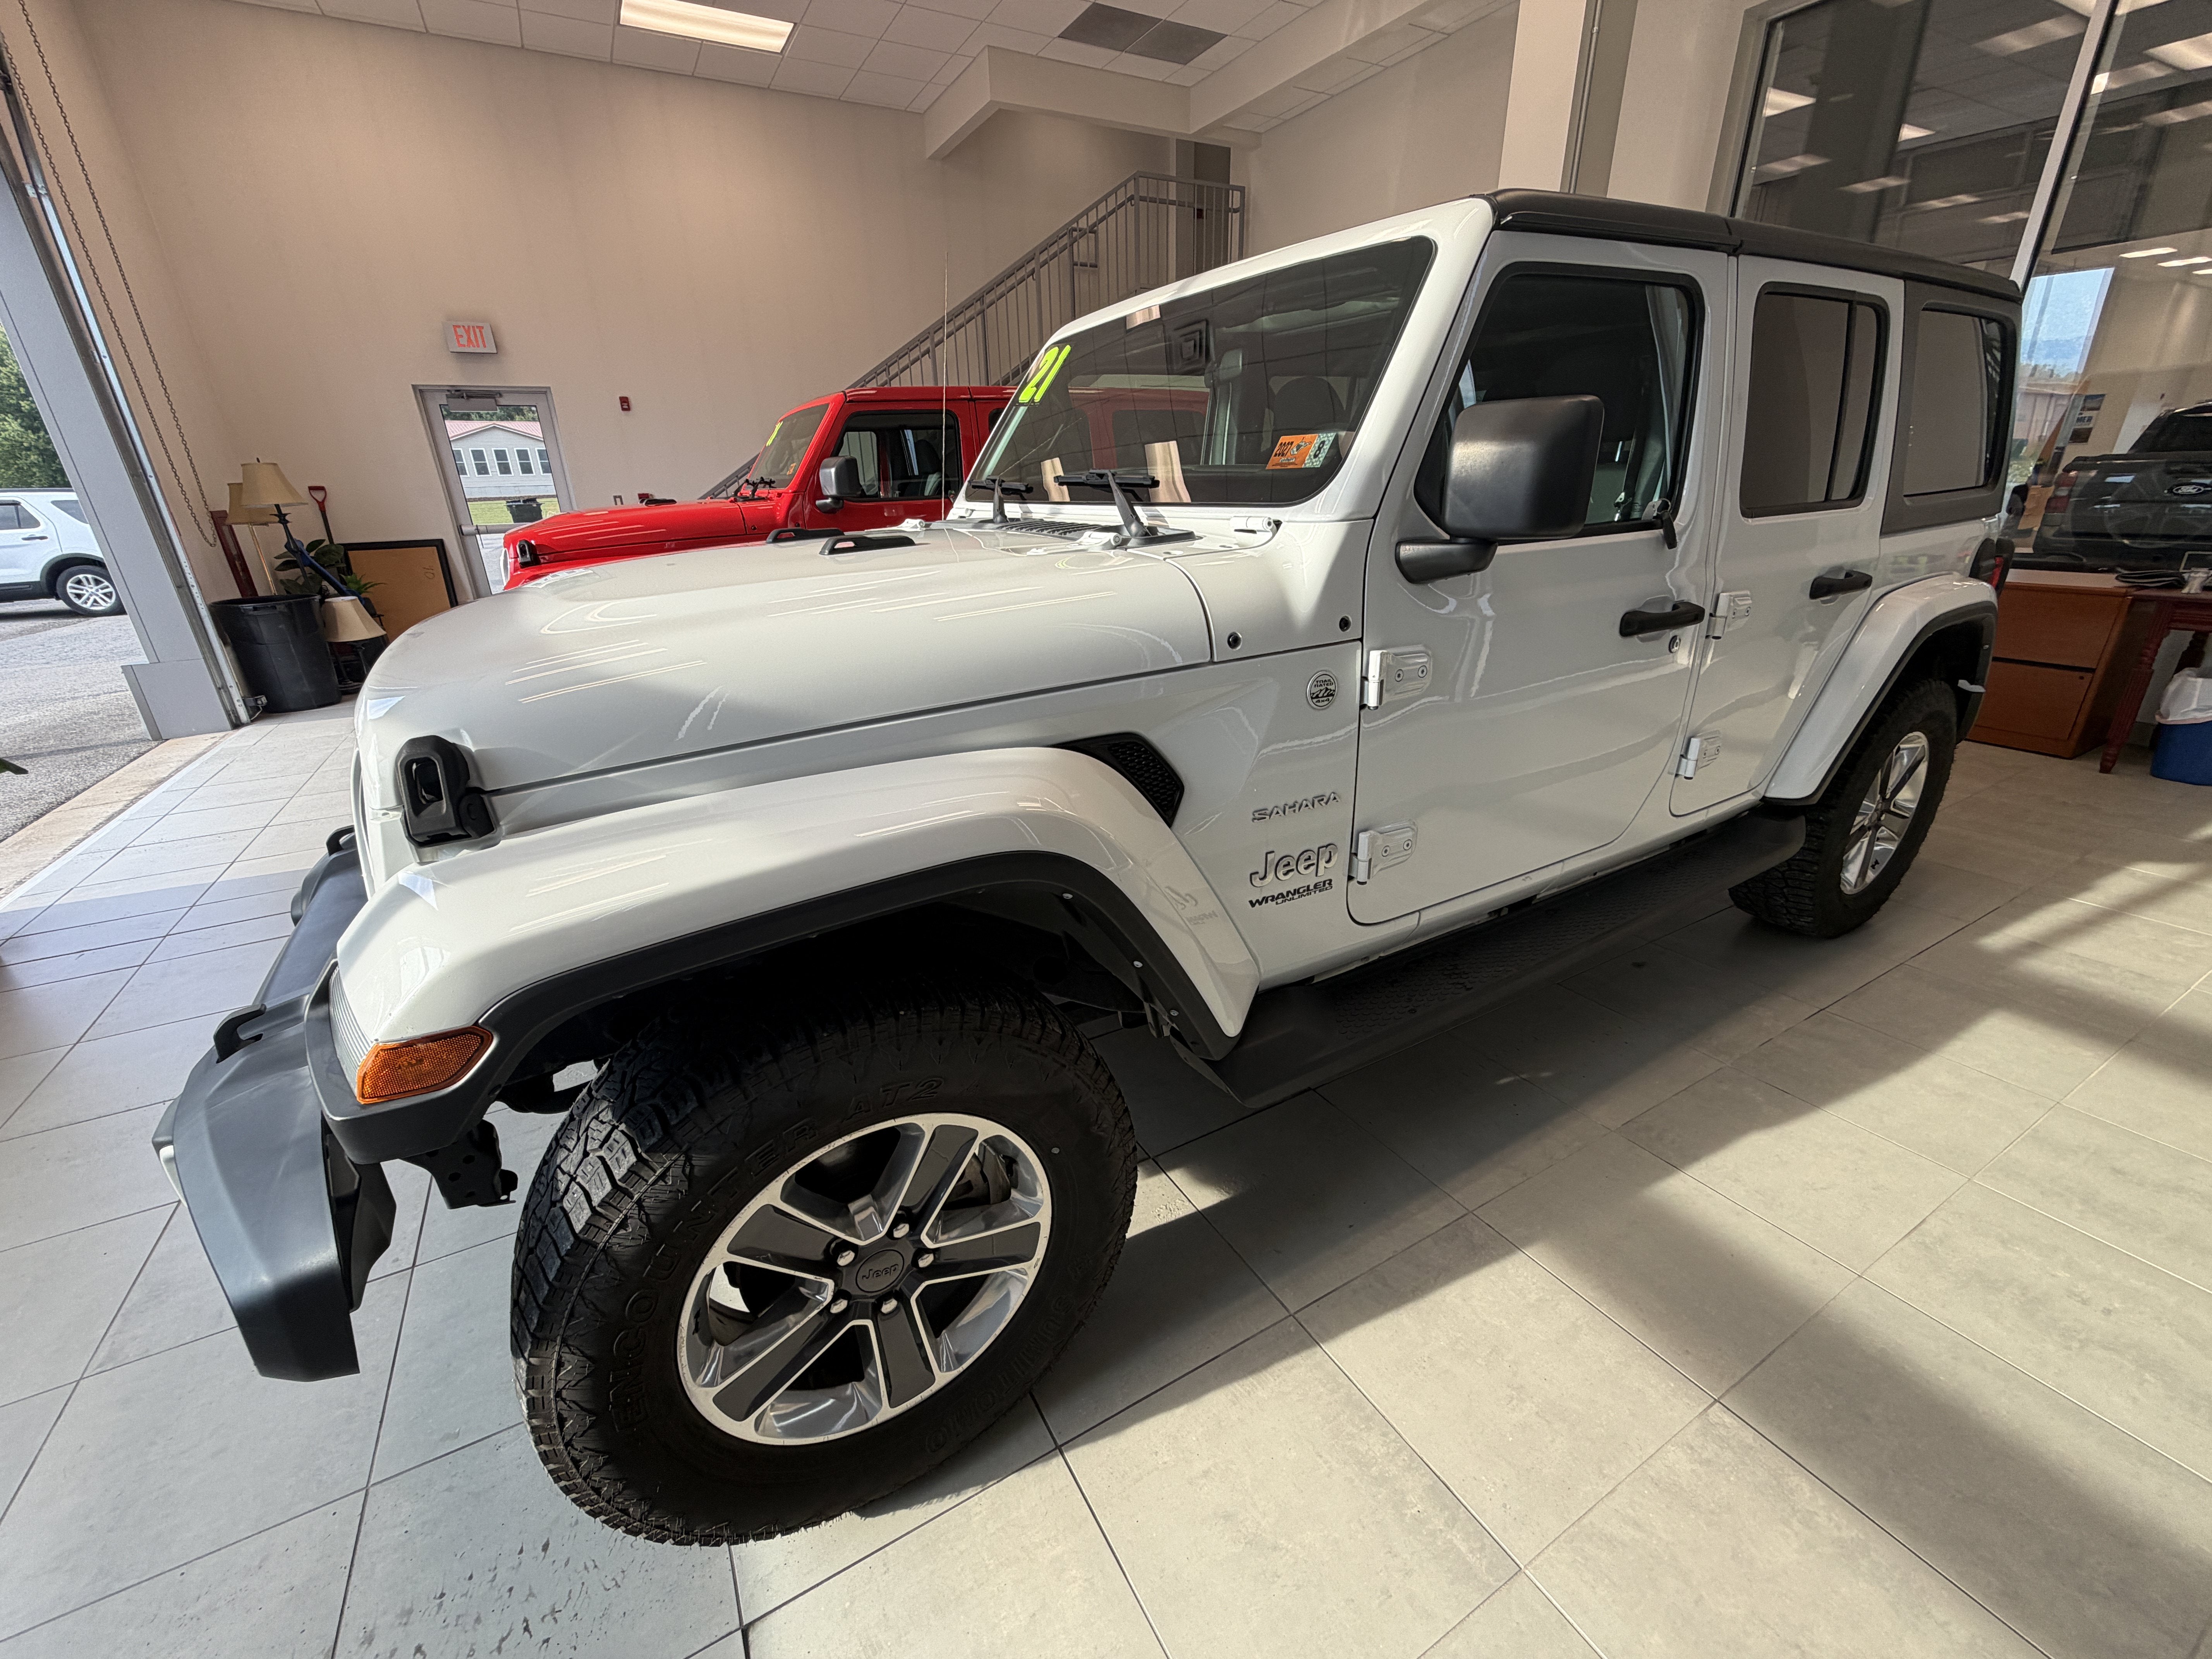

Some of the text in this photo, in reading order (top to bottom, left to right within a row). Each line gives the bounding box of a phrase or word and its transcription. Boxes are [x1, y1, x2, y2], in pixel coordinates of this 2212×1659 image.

[452, 325, 487, 348] EXIT
[1018, 344, 1072, 403] 21
[1274, 441, 1294, 457] 2027
[1313, 440, 1326, 459] 8
[1252, 792, 1341, 823] SAHARA
[1249, 843, 1338, 888] Jeep
[1248, 879, 1333, 908] WRANGLER
[1275, 886, 1333, 905] UNLIMITED
[607, 1116, 818, 1434] ENCOUNTER
[862, 1263, 900, 1281] Jeep
